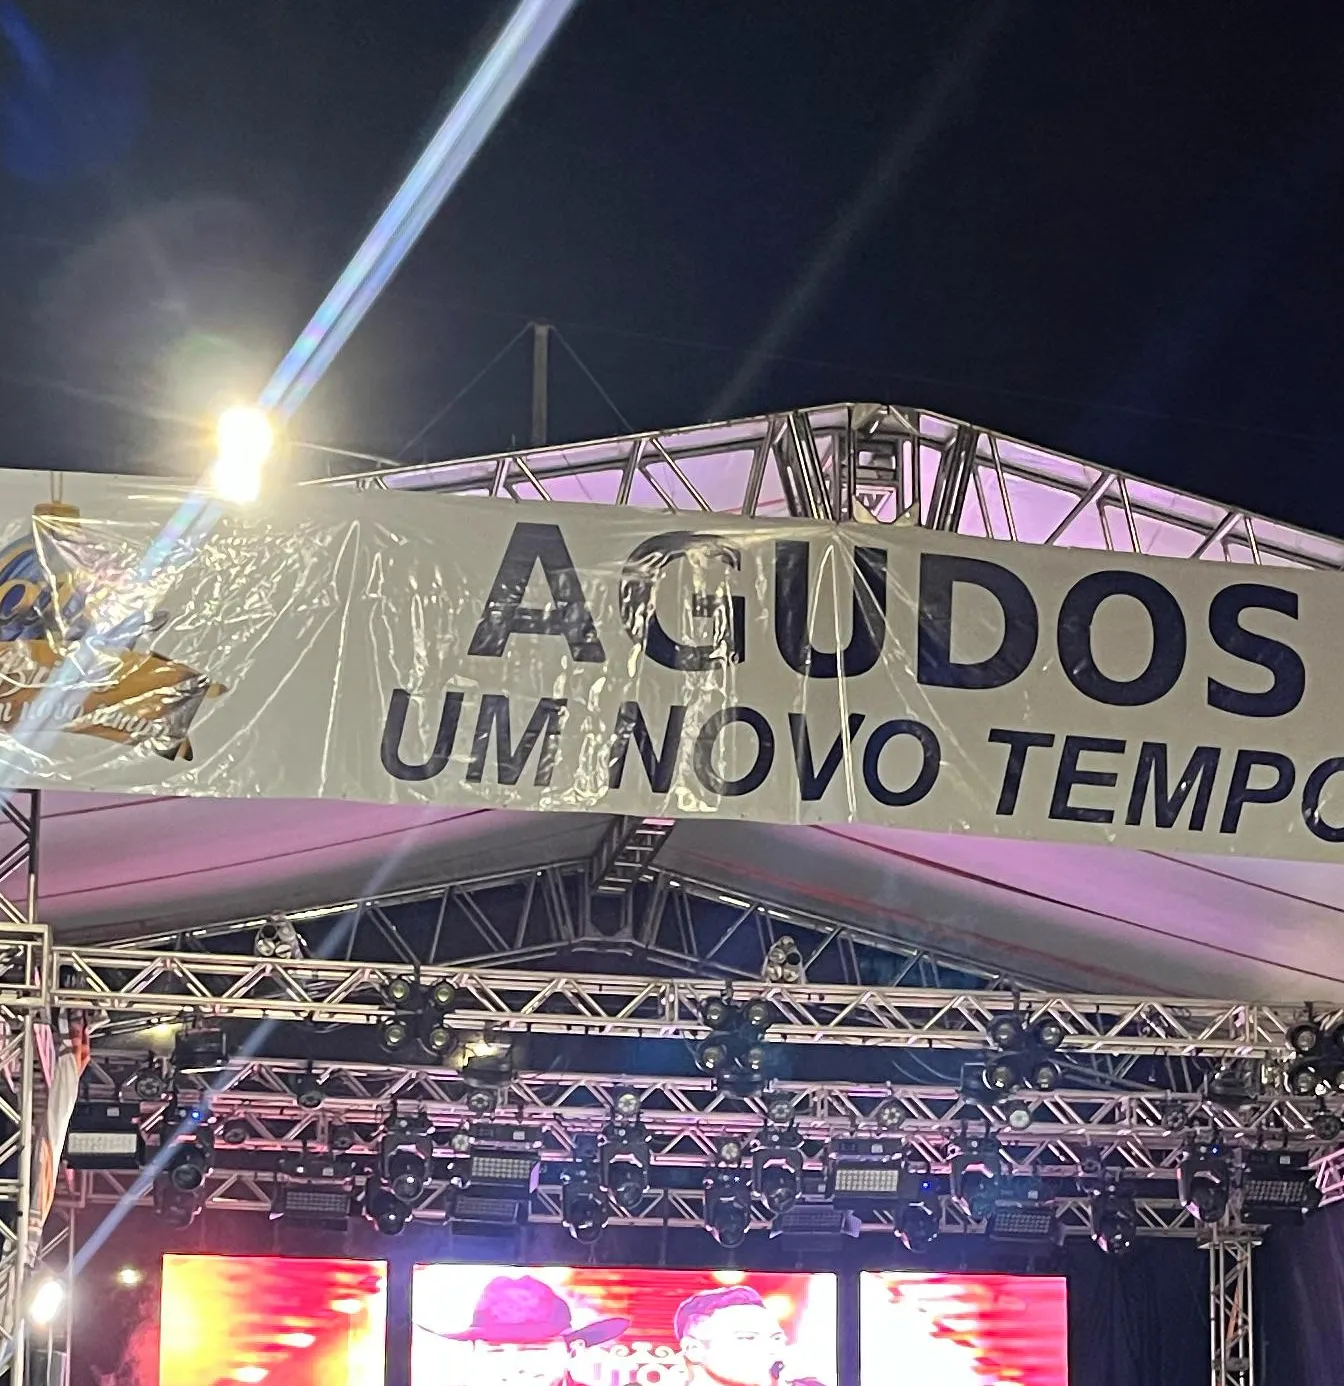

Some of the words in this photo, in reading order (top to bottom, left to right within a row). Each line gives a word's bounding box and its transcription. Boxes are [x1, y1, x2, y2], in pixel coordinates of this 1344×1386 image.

[467, 521, 1307, 718] AGUDOS
[379, 688, 568, 787] UM
[608, 701, 942, 806] NOVO
